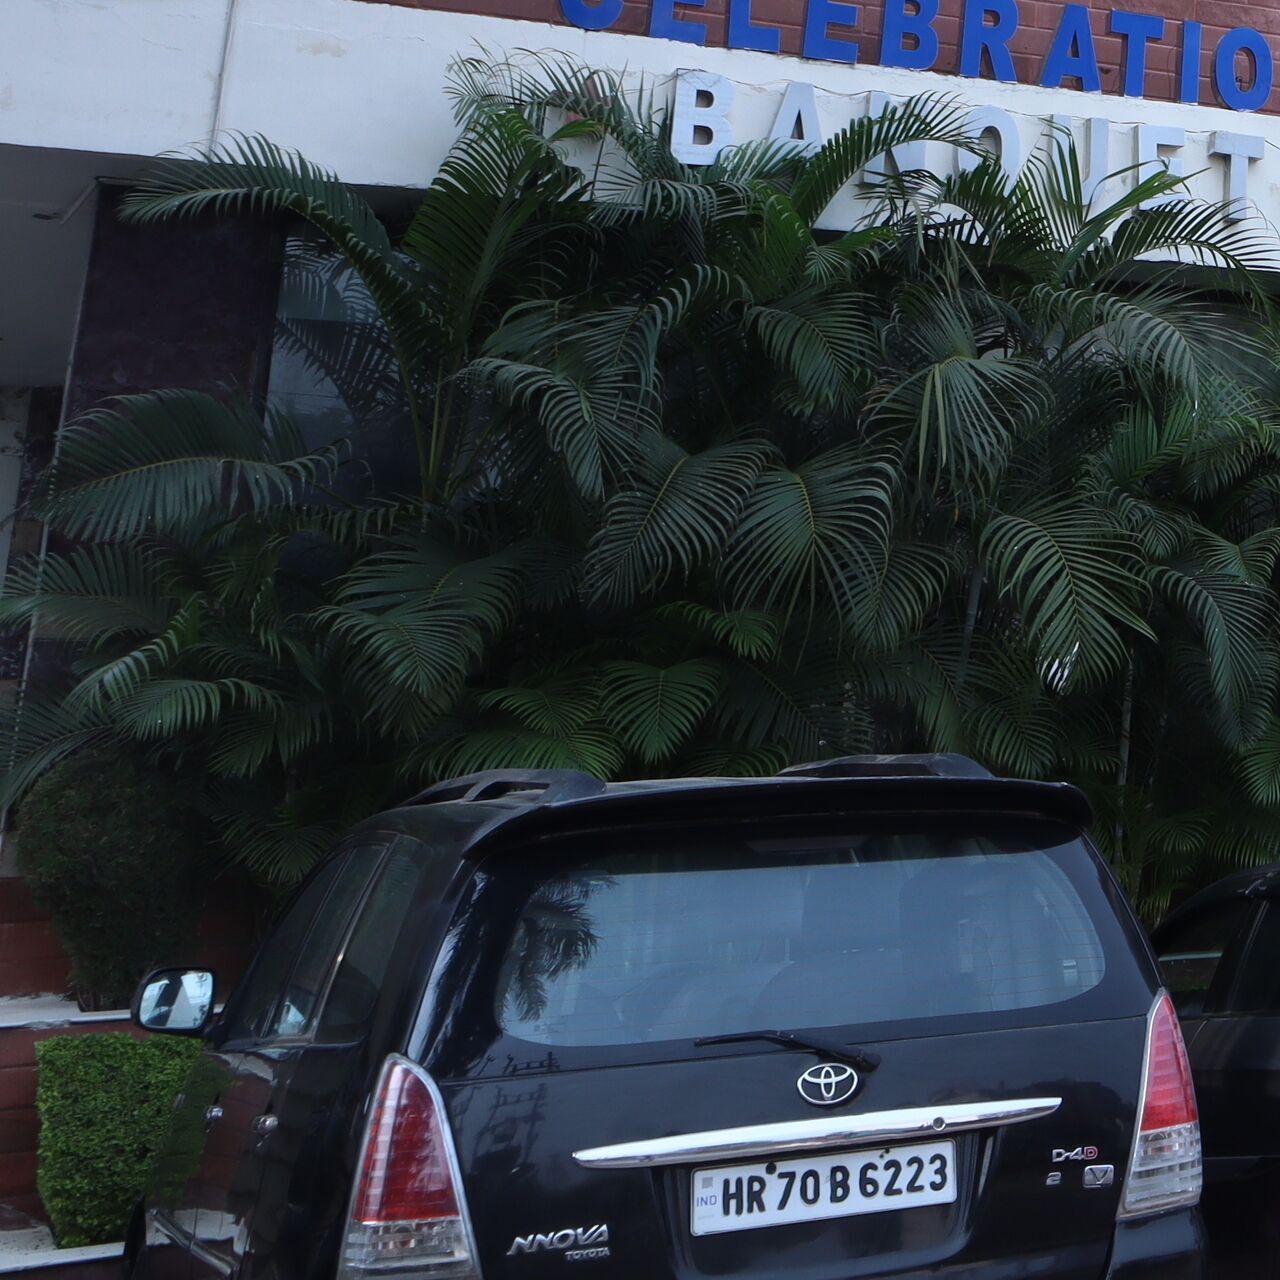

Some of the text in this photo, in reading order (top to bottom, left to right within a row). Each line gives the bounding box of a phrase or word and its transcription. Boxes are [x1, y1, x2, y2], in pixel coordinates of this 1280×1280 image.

[1052, 1146, 1098, 1163] D-4D
[696, 1194, 718, 1207] IND
[564, 1246, 611, 1261] TOYOTA
